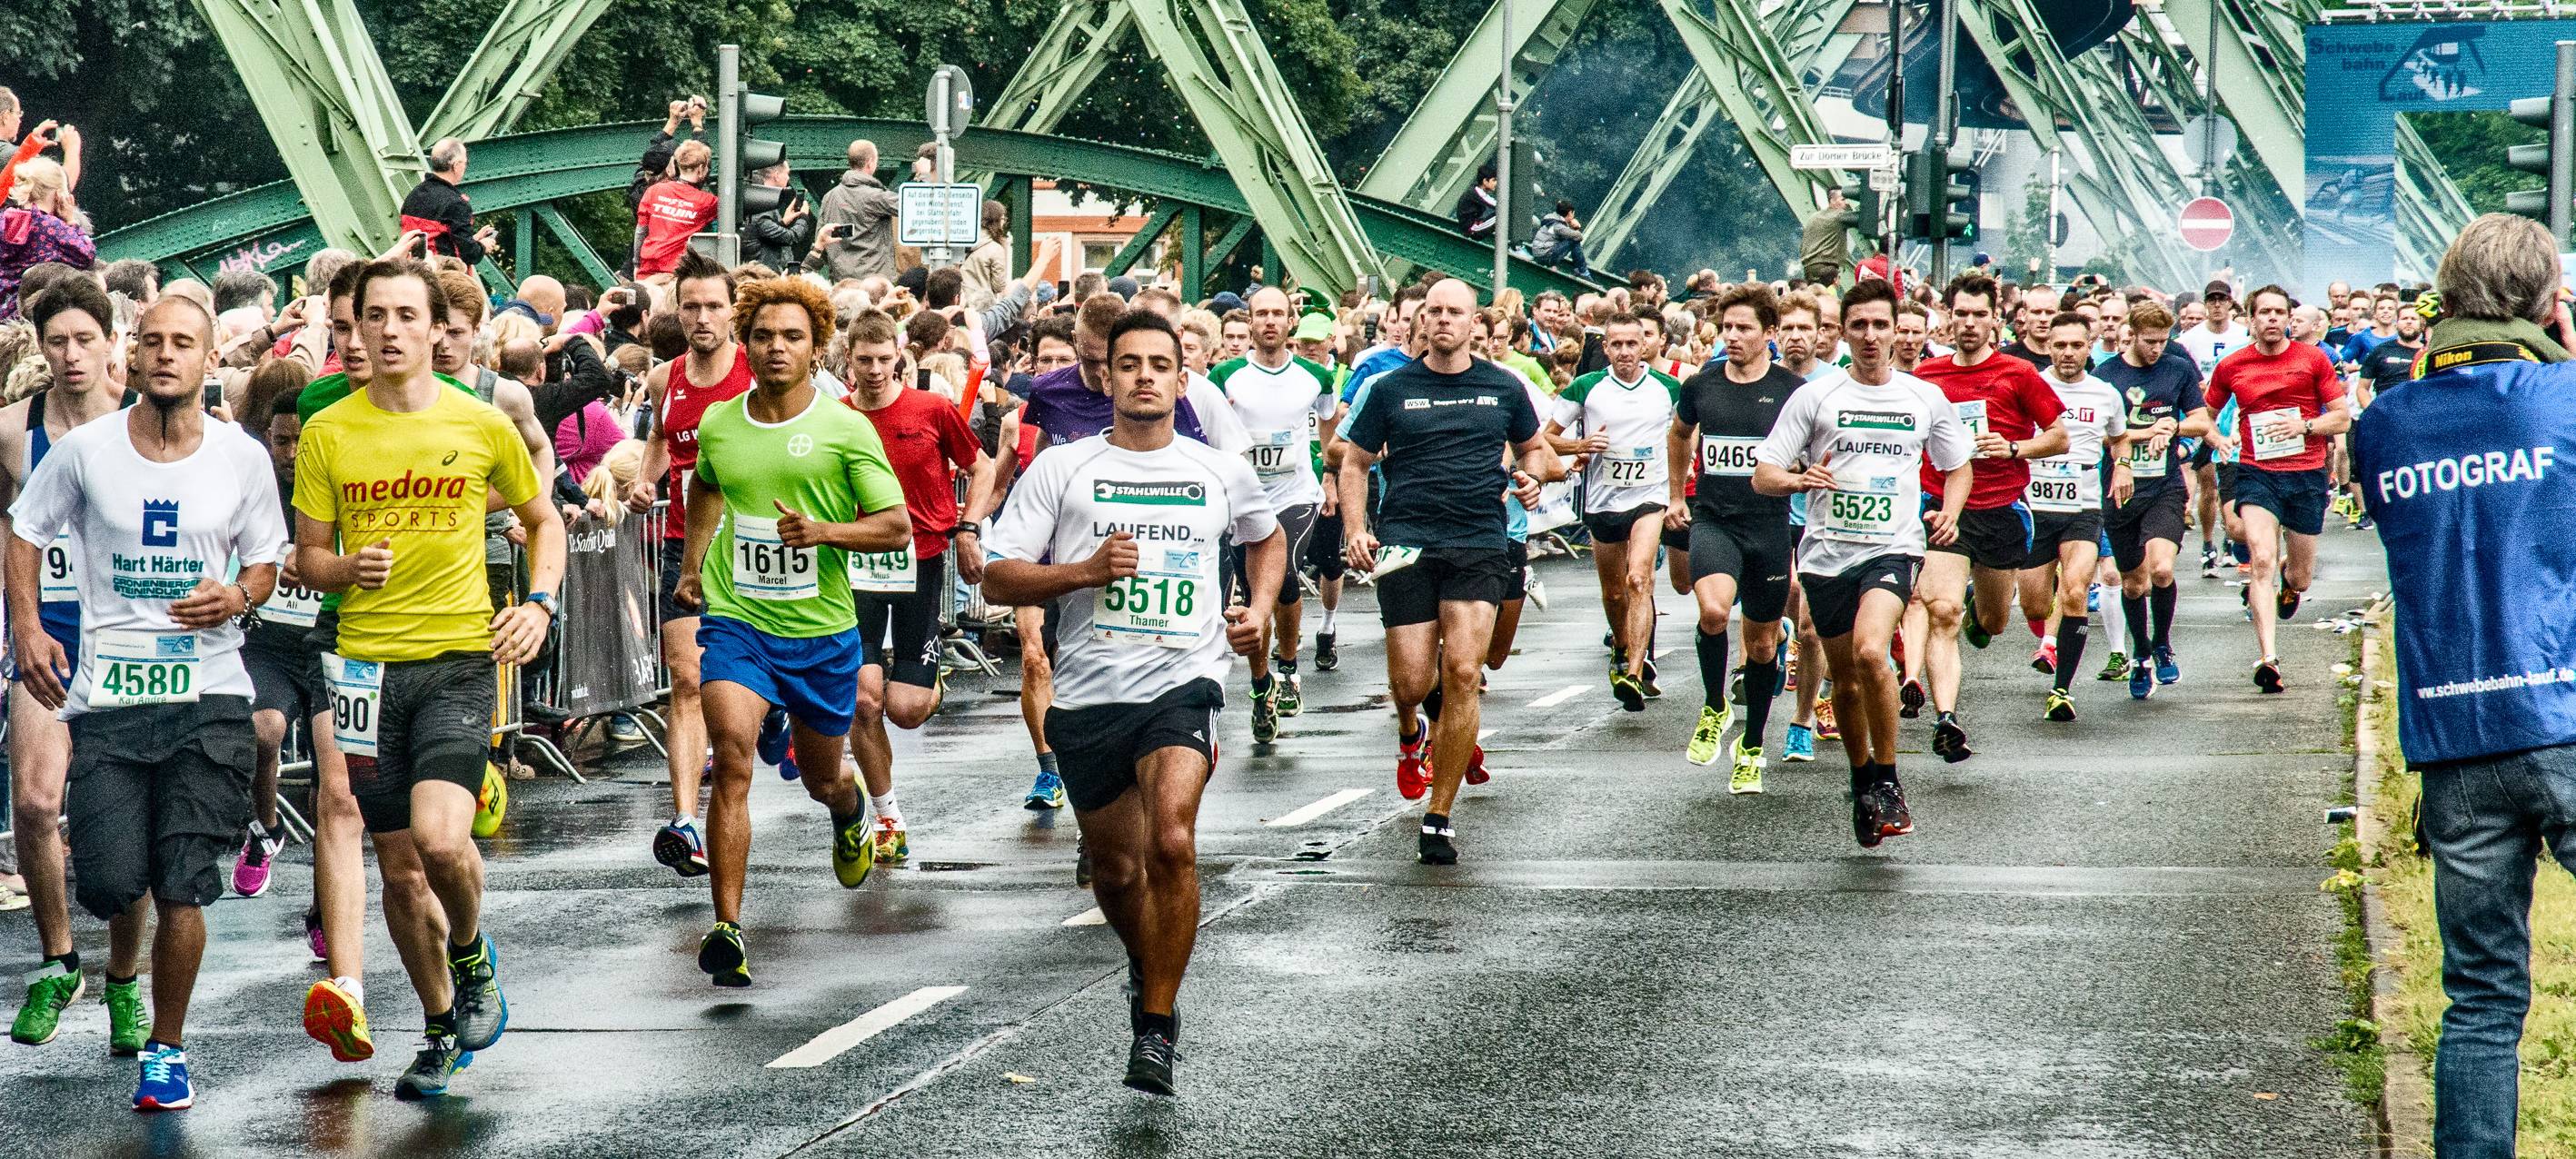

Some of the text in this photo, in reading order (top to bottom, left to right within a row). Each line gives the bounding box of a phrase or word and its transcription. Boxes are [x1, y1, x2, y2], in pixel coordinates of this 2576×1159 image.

[2309, 37, 2395, 54] Schwebe
[2342, 58, 2387, 71] bahn
[1799, 151, 1815, 161] Zur
[2434, 350, 2472, 369] Nikon
[1853, 413, 1905, 424] STAHLWILLE
[676, 431, 691, 443] LG
[1051, 433, 1067, 445] We
[1248, 447, 1284, 467] 107
[1612, 461, 1646, 480] 272
[2378, 446, 2555, 504] FOTOGRAF
[342, 469, 467, 503] medora
[1115, 485, 1190, 497] STAHLWILLE
[2031, 480, 2077, 500] 9878
[1832, 492, 1892, 522] 5523
[351, 510, 457, 528] SPORTS
[1844, 520, 1878, 530] Benjamin
[113, 552, 204, 573] Hart Härter
[740, 541, 810, 576] 1615
[758, 574, 788, 586] Marcel
[285, 600, 298, 610] Ali
[1104, 577, 1196, 617] 5518
[1129, 614, 1170, 628] Thamer
[102, 662, 191, 696] 4580
